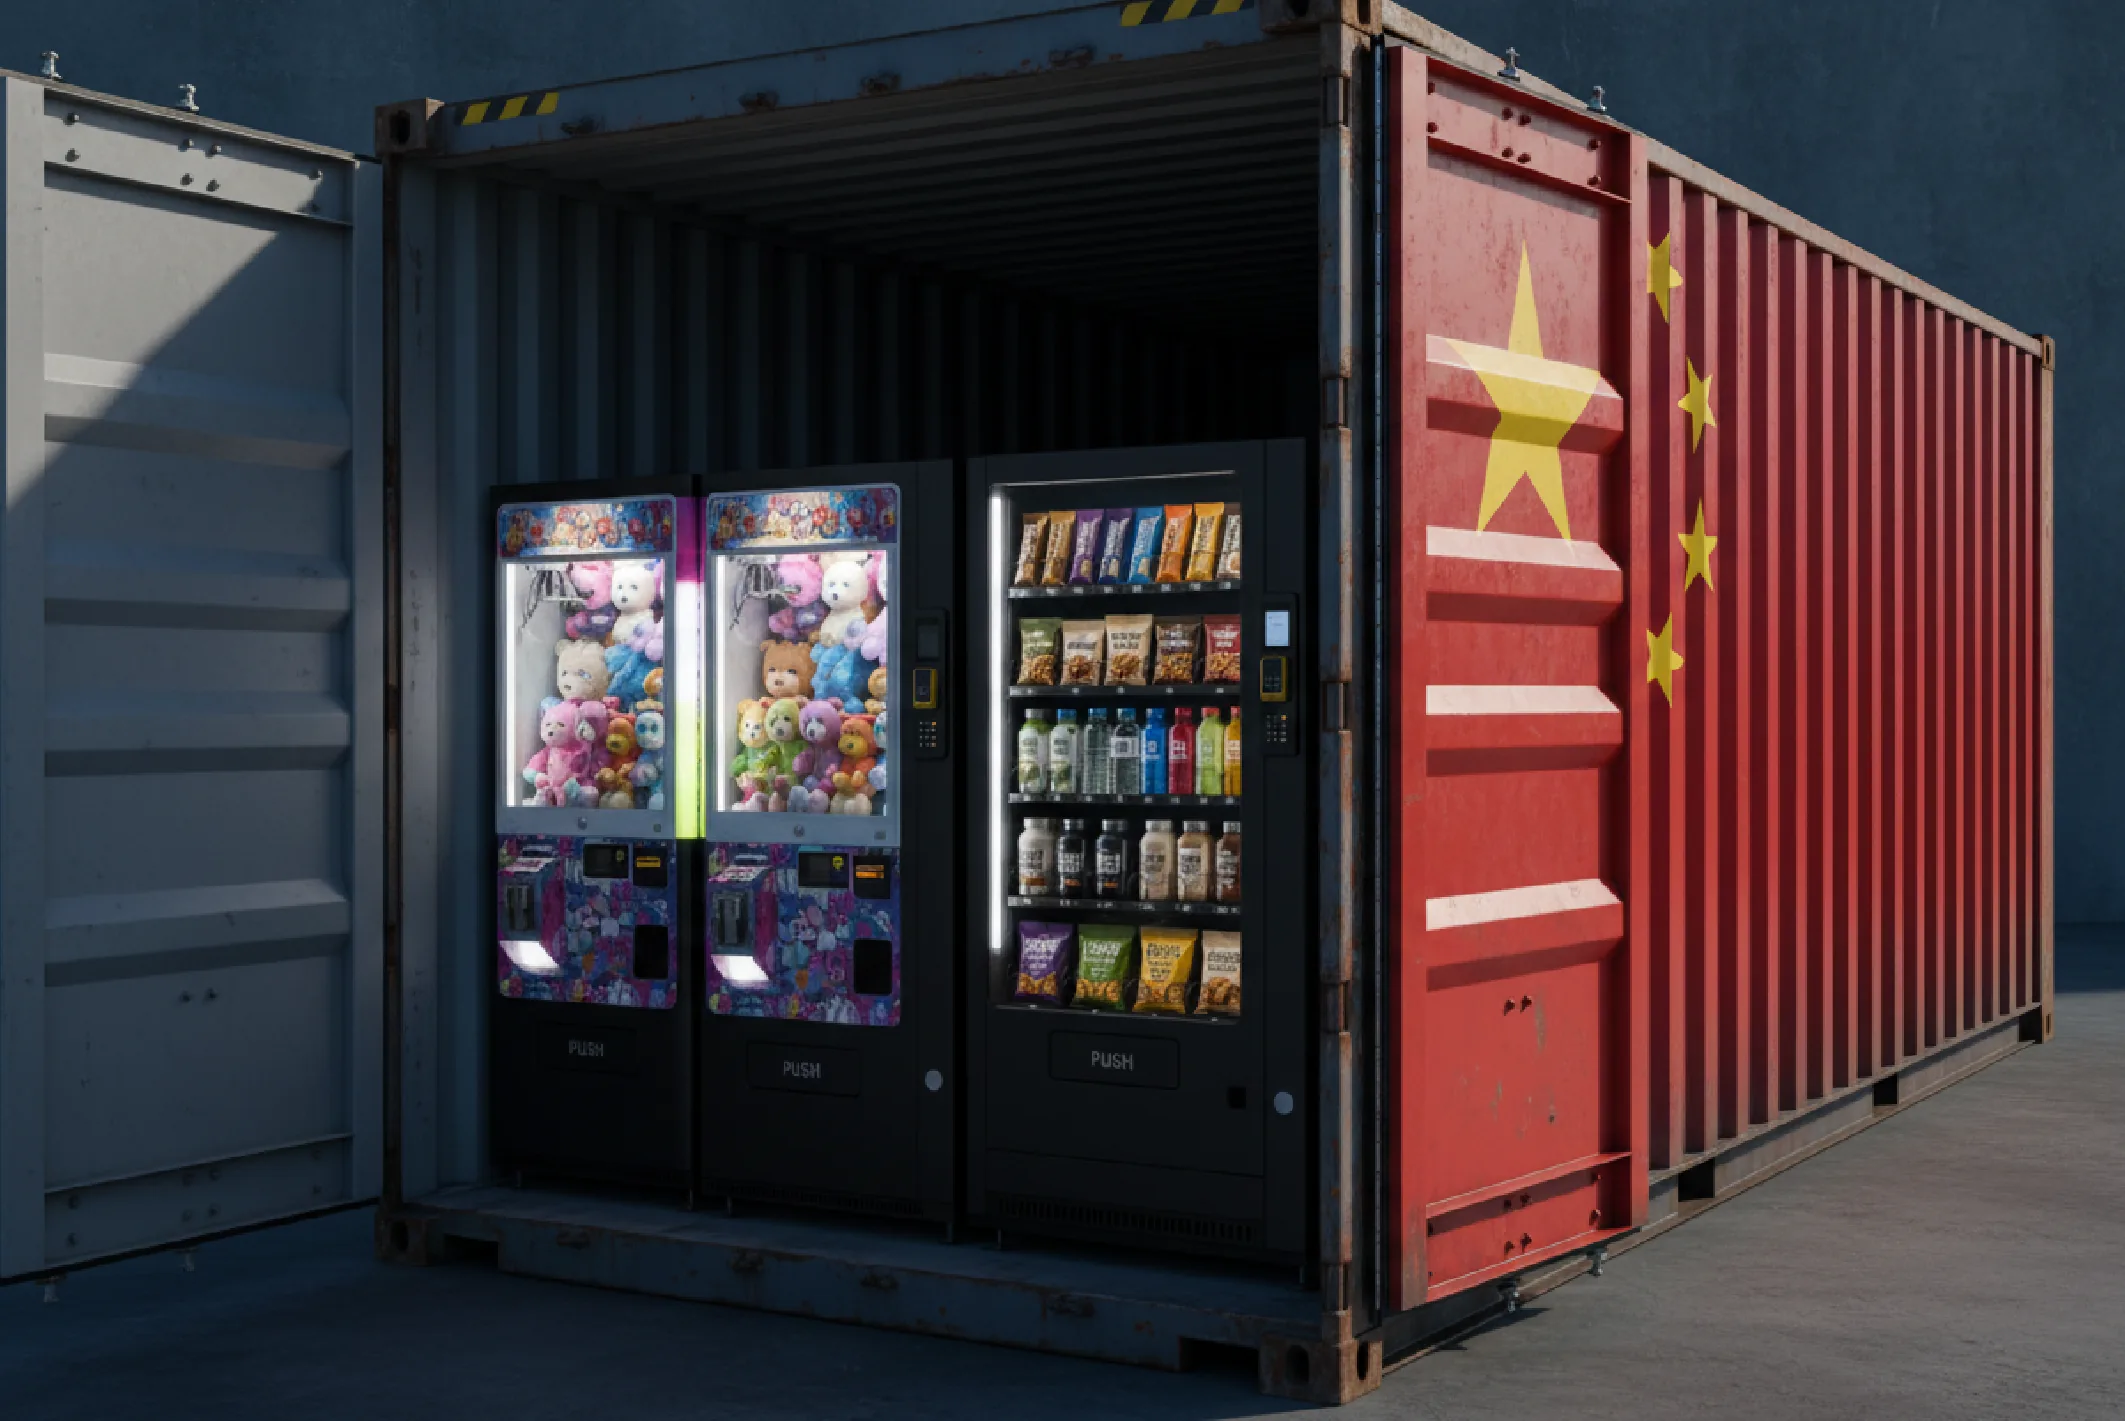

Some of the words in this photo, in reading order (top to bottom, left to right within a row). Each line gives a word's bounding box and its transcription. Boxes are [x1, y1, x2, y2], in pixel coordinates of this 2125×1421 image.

[568, 1039, 604, 1057] PUSH
[783, 1061, 821, 1079] PUSH
[1091, 1051, 1133, 1071] PUSH
